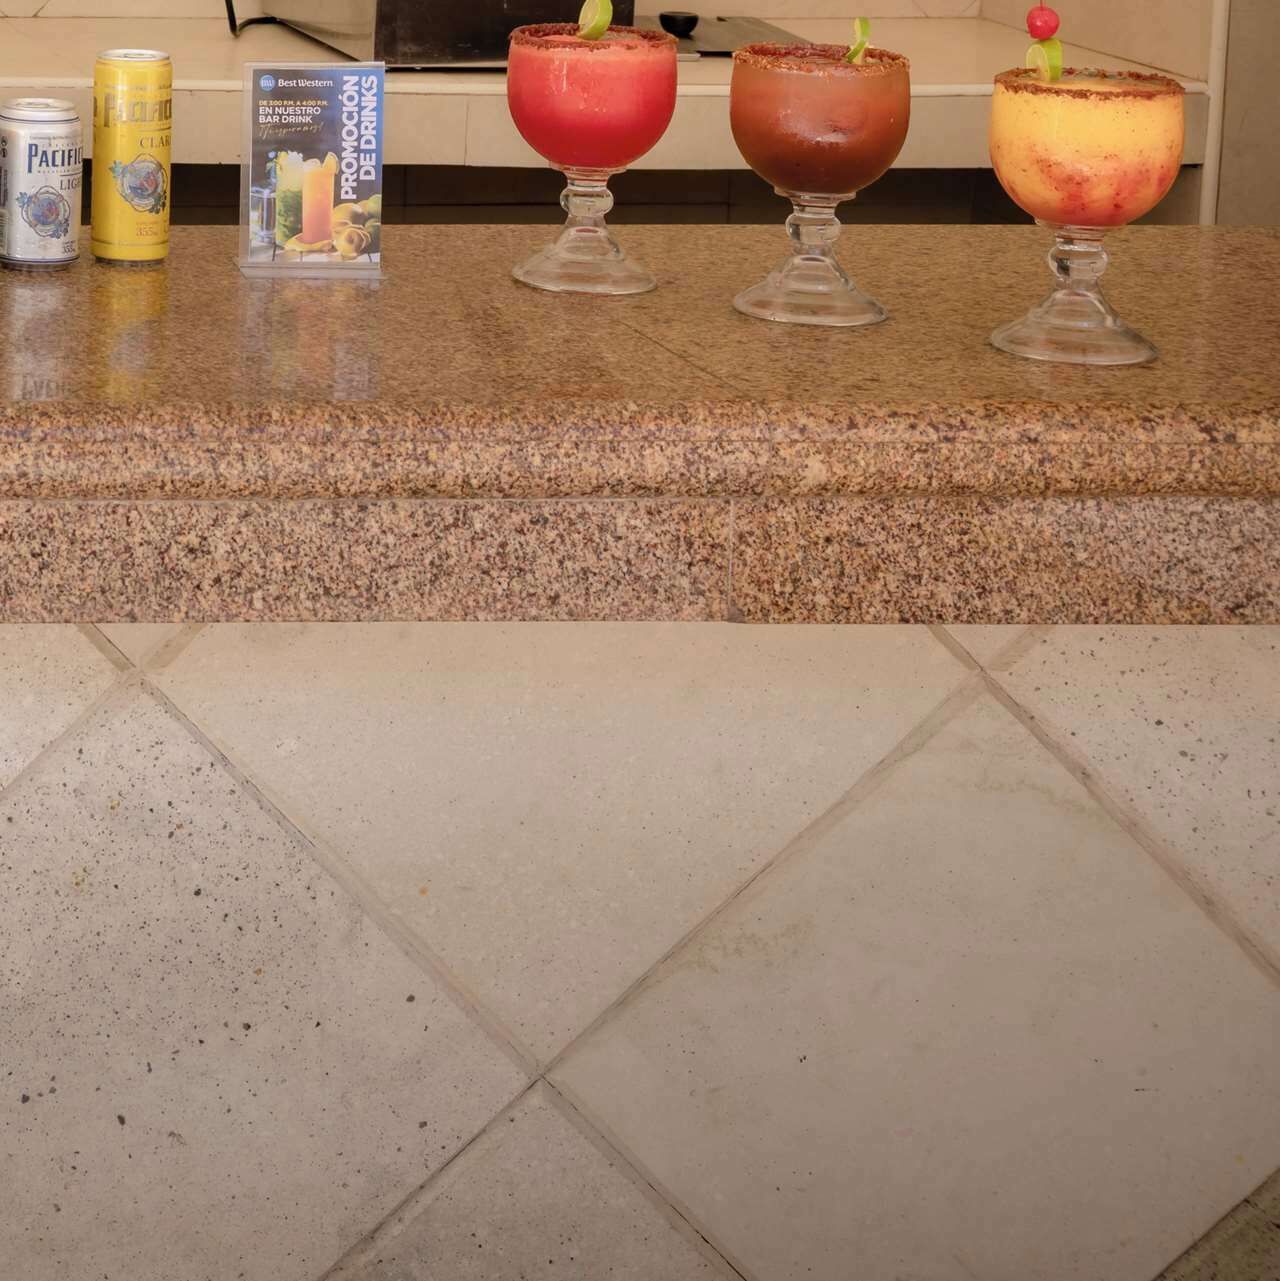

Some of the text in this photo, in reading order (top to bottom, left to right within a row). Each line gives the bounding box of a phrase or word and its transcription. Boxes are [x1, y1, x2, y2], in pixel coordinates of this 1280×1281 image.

[278, 78, 297, 87] Best
[298, 79, 333, 88] Western
[103, 92, 171, 128] PACIFIC
[258, 115, 313, 123] BAR DRINK
[259, 106, 321, 115] EN NUESTRO
[339, 75, 359, 200] PROMOCIÓN
[359, 75, 378, 180] DE DRINKS
[27, 143, 83, 173] PACIFIC
